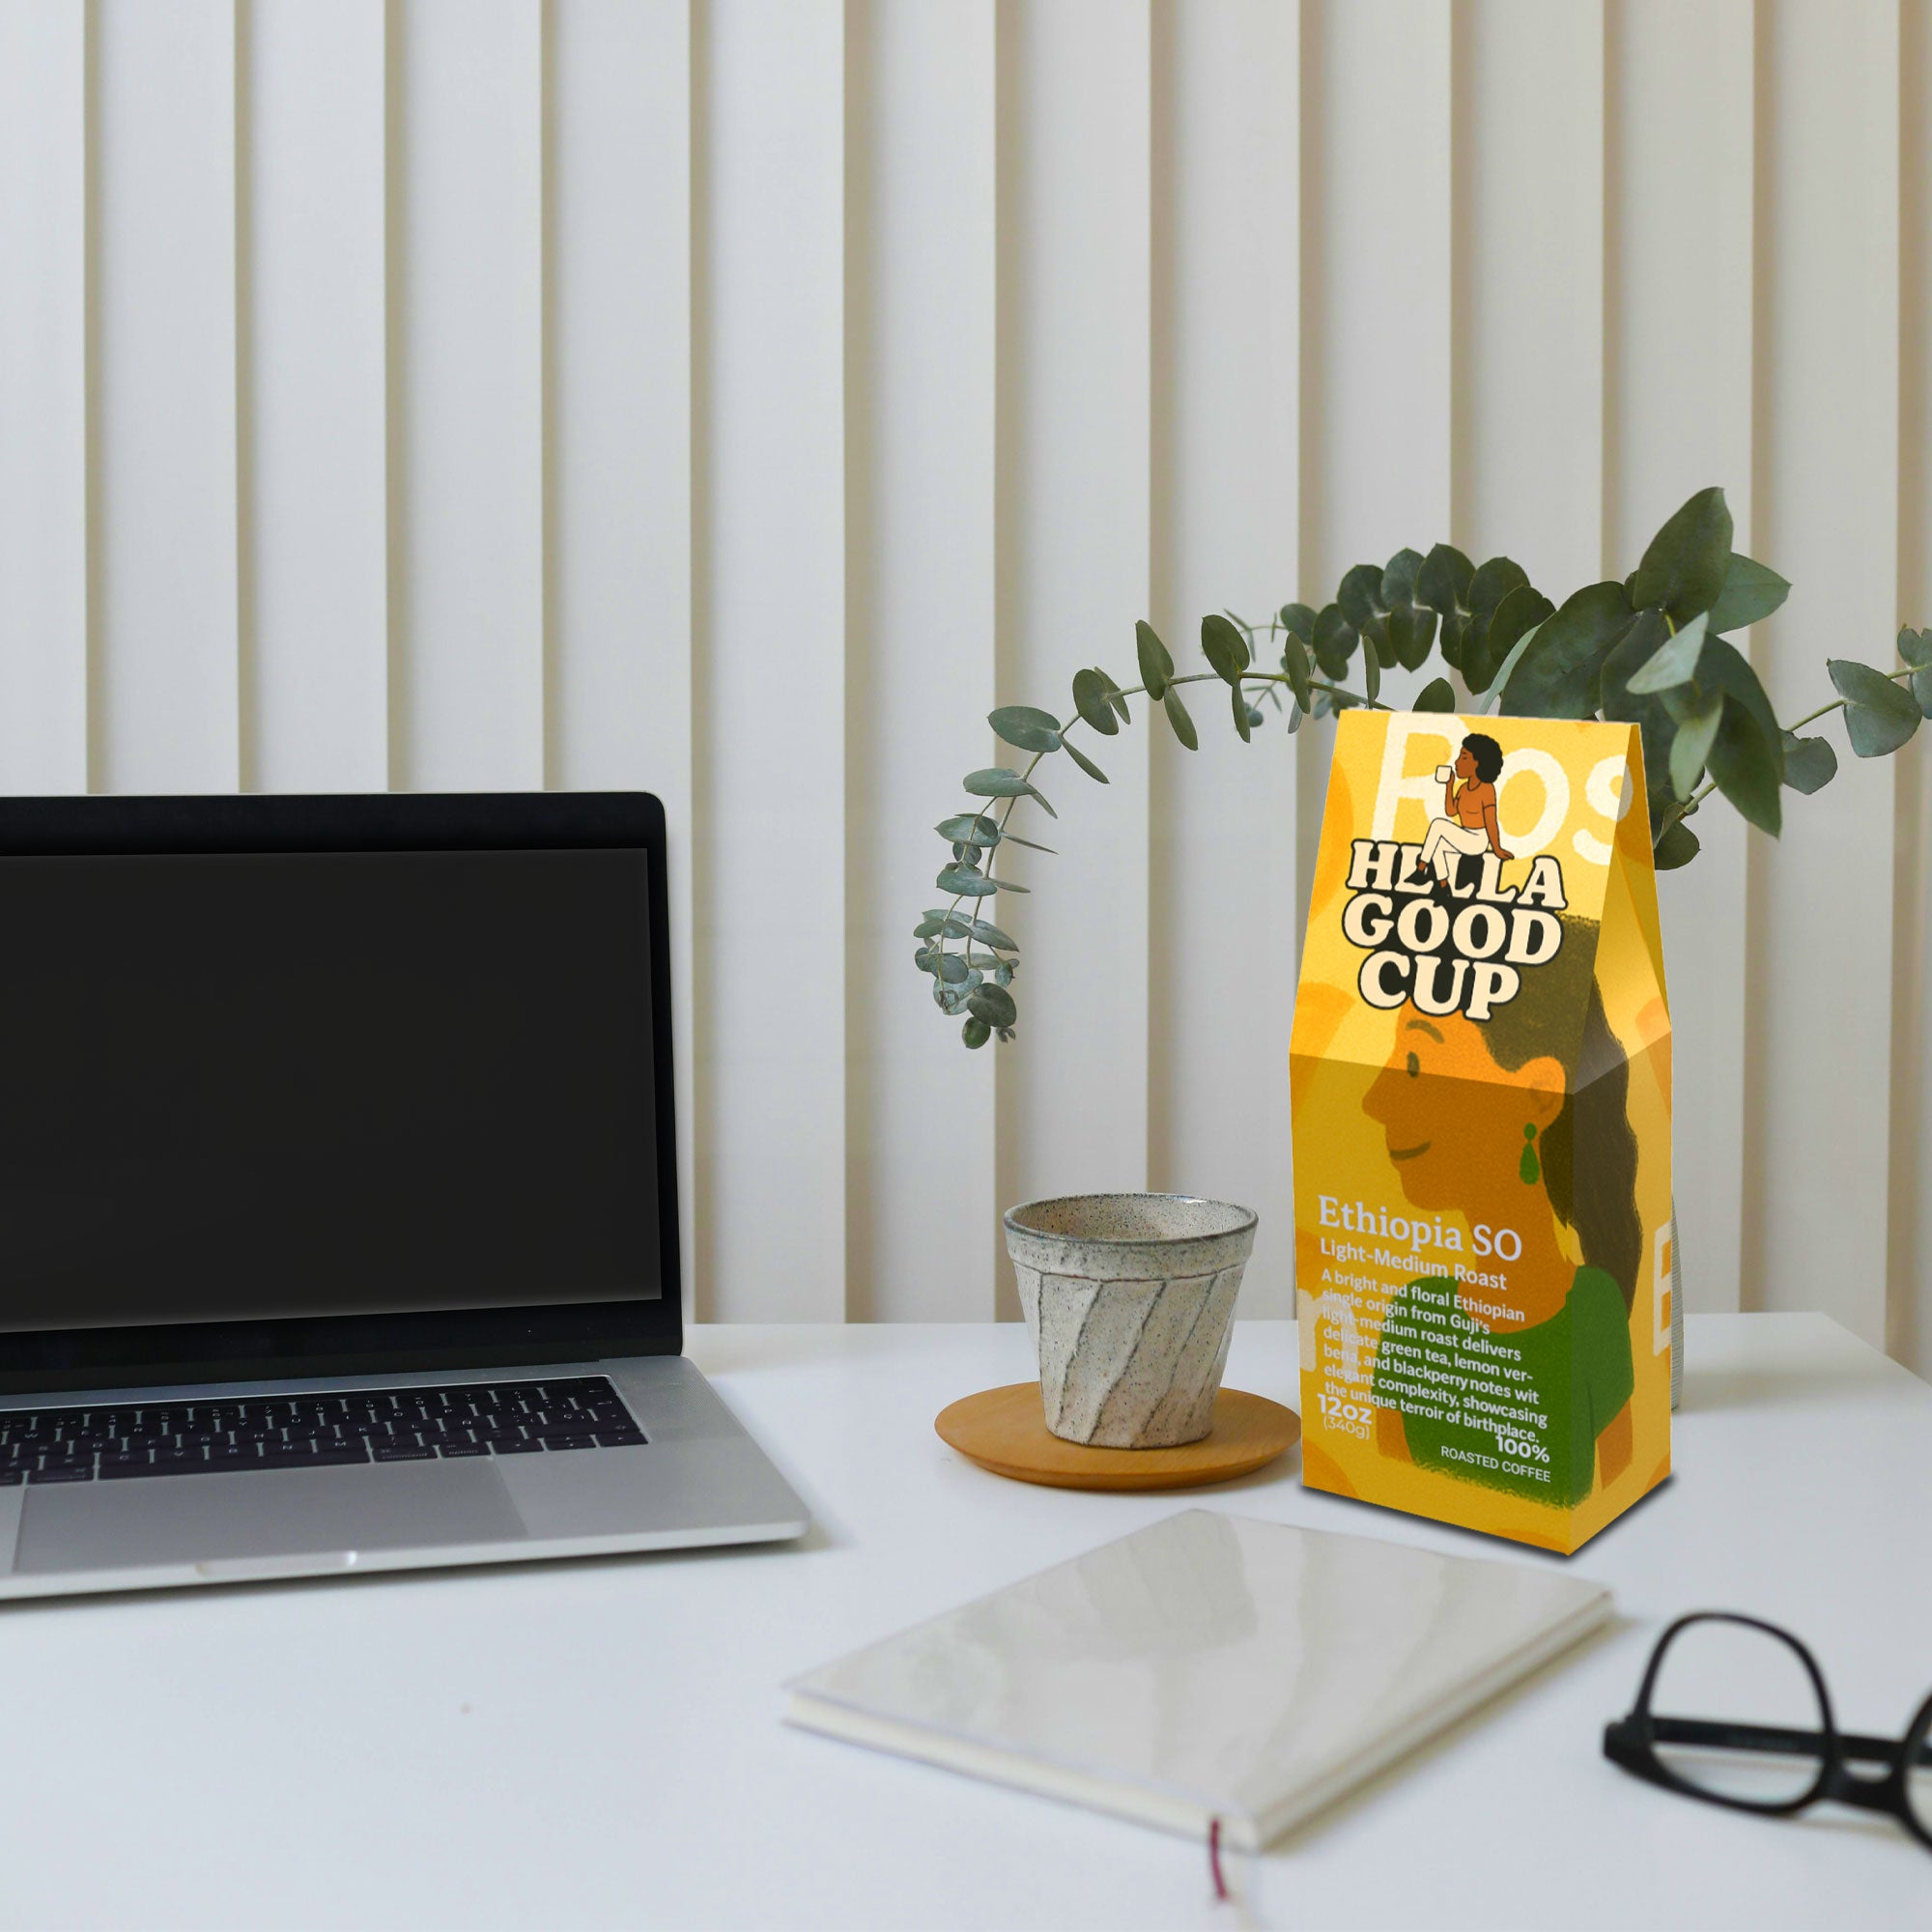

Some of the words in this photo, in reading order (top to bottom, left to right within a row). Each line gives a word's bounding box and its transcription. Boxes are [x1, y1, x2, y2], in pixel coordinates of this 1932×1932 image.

[1343, 894, 1563, 966] GOOD
[1359, 950, 1520, 1020] CUP
[1319, 1194, 1462, 1253] Ethiopia
[1472, 1224, 1522, 1262] SO
[1321, 1237, 1448, 1279] Light-Medium
[1454, 1264, 1507, 1291] Roast
[1321, 1268, 1331, 1283] A
[1335, 1270, 1378, 1292] bright
[1381, 1283, 1407, 1297] and
[1411, 1286, 1449, 1307] floral
[1454, 1295, 1525, 1321] Ethiopian
[1322, 1290, 1362, 1307] single
[1366, 1299, 1407, 1318] origin
[1411, 1305, 1446, 1325] from
[1450, 1314, 1490, 1335] Guji's
[1322, 1306, 1417, 1339] light-medium
[1421, 1326, 1459, 1349] roast
[1462, 1336, 1521, 1361] delivers
[1323, 1326, 1378, 1349] delicate
[1381, 1340, 1421, 1361] green
[1425, 1350, 1451, 1368] tea,
[1455, 1354, 1499, 1377] lemon
[1503, 1368, 1533, 1381] ver-
[1324, 1364, 1375, 1386] elegant
[1378, 1377, 1459, 1407] complexity,
[1463, 1396, 1548, 1430] showcasing
[1364, 1356, 1390, 1371] and
[1470, 1379, 1511, 1398] notes
[1515, 1389, 1539, 1405] wit
[1318, 1393, 1372, 1424] 12oz
[1323, 1418, 1370, 1440] (340g)
[1325, 1380, 1347, 1398] the
[1350, 1389, 1396, 1409] unique
[1401, 1399, 1444, 1421] terroir
[1446, 1411, 1461, 1424] of
[1464, 1413, 1539, 1443] birthplace.
[1440, 1446, 1498, 1469] ROASTED
[1502, 1461, 1550, 1482] COFFEE
[1496, 1435, 1550, 1463] 100%
